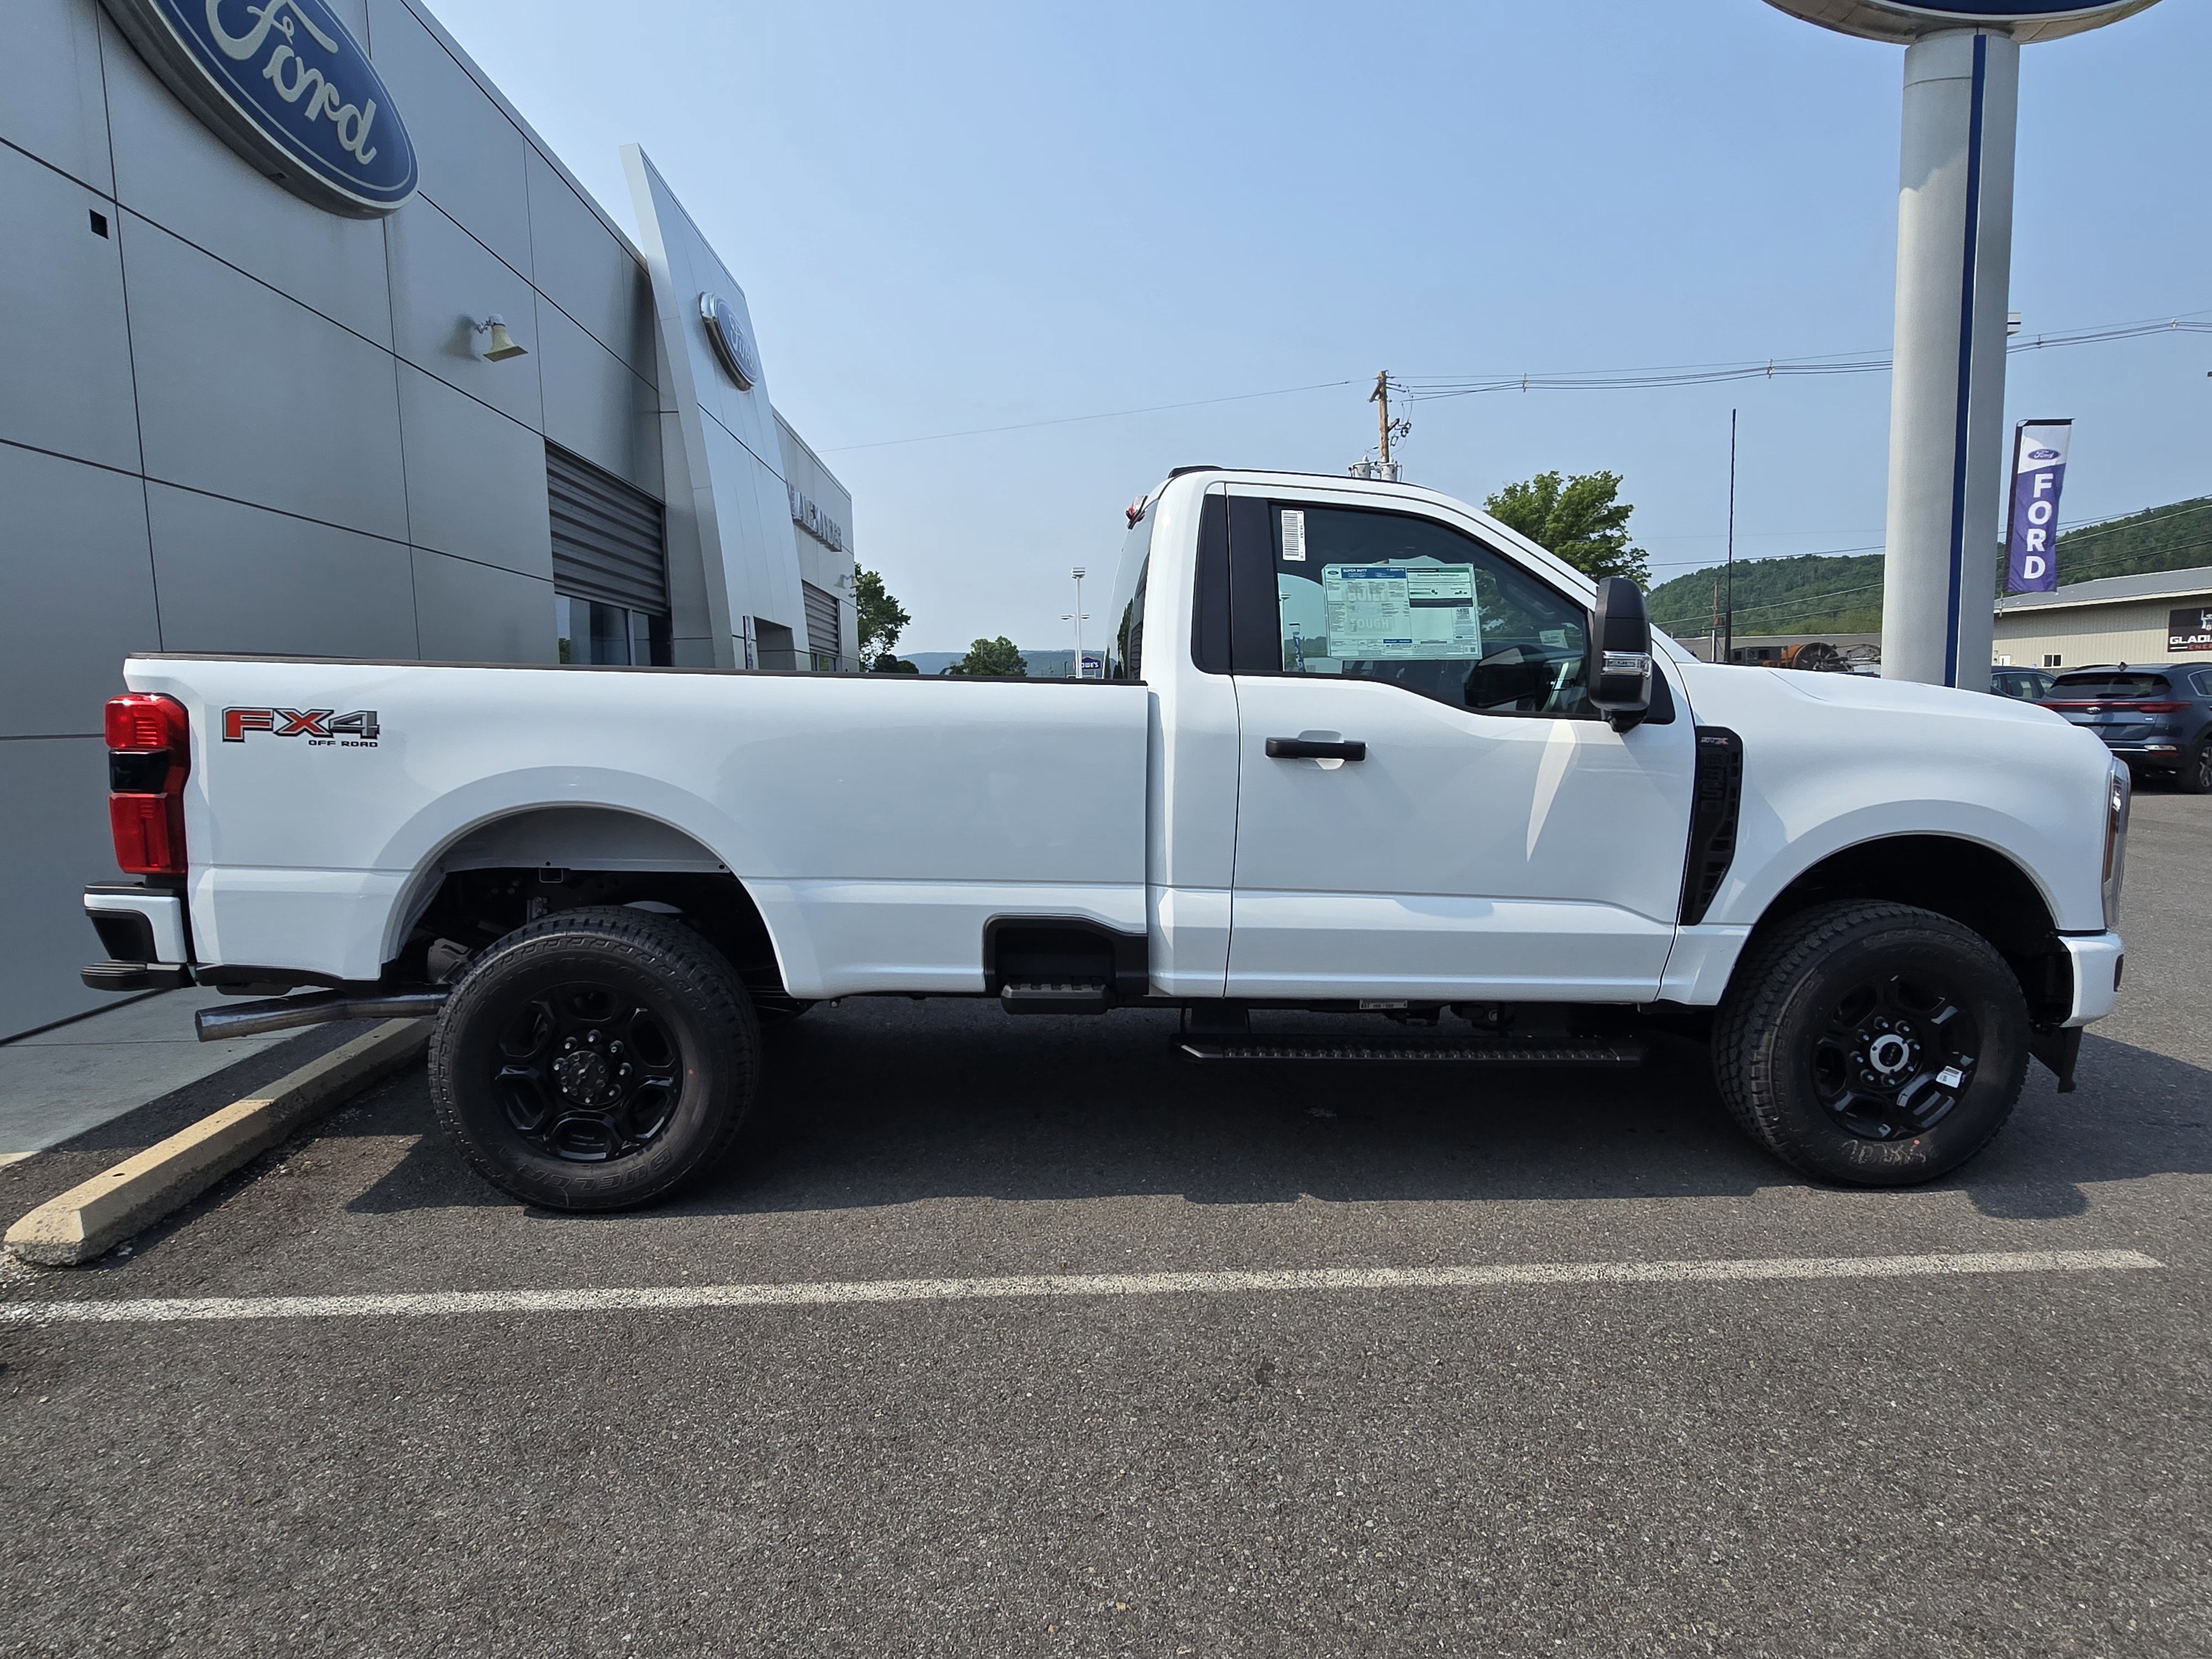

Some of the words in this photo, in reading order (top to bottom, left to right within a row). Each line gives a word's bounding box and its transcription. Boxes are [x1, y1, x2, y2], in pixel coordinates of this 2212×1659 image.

[205, 0, 377, 164] Ford
[2023, 473, 2054, 580] FORD
[2169, 634, 2212, 644] GLADI
[222, 706, 380, 743] FX4
